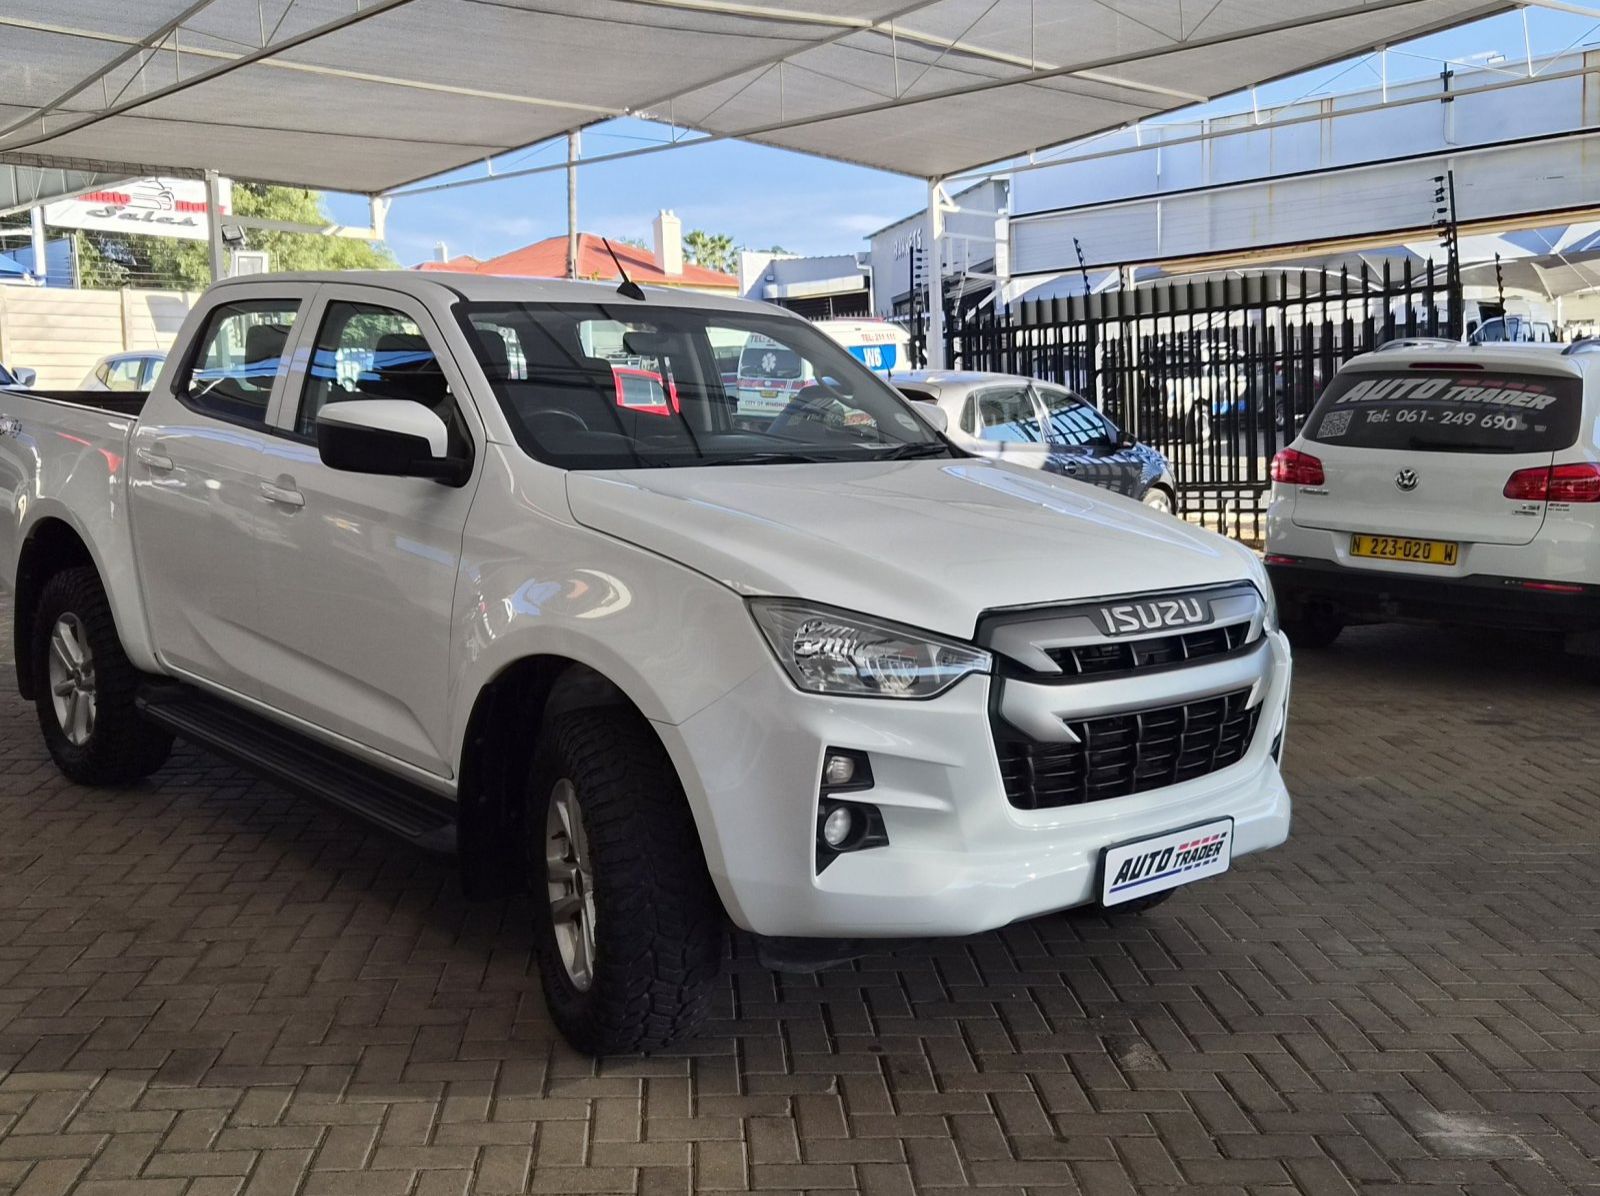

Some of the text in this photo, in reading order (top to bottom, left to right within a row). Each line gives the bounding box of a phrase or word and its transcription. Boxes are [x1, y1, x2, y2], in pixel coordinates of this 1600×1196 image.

[86, 205, 198, 227] Sales
[1336, 378, 1557, 410] AUTO TRADER
[1366, 410, 1390, 423] Tel:
[1440, 412, 1476, 427] 249
[1480, 415, 1518, 431] 690
[1351, 536, 1454, 562] N 223-020 W
[1100, 597, 1203, 633] ISUZU
[1112, 840, 1225, 886] AUTO TRADER
